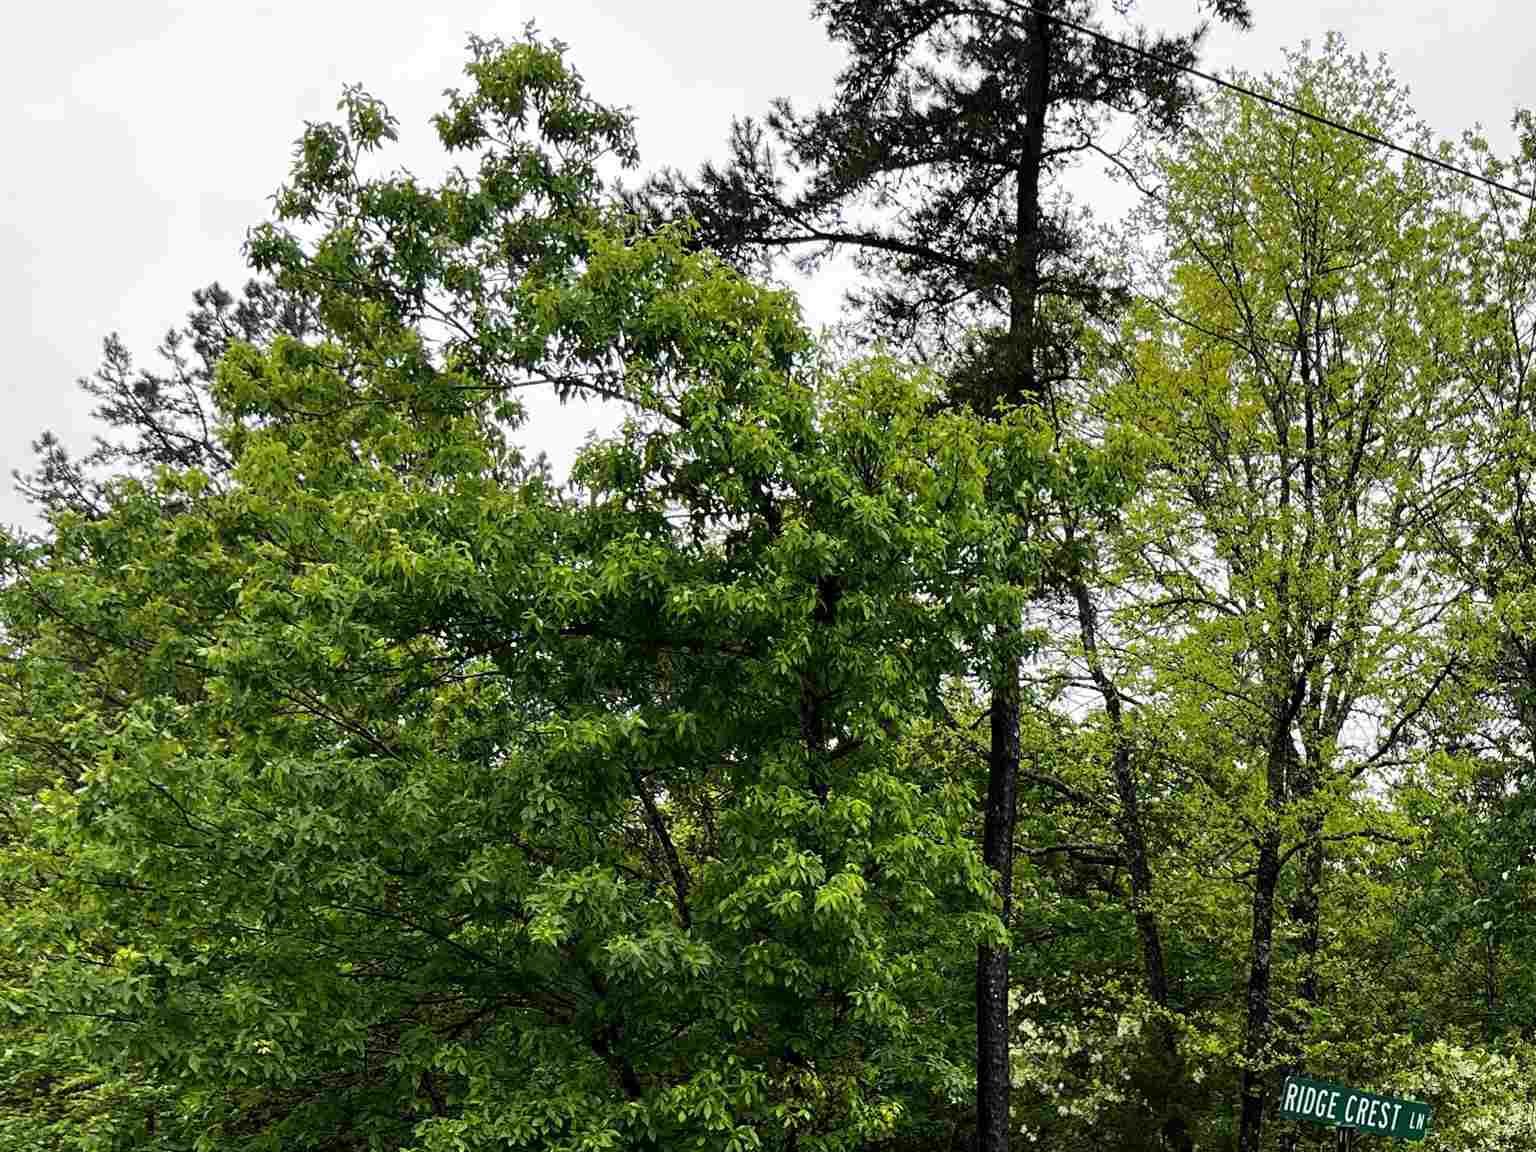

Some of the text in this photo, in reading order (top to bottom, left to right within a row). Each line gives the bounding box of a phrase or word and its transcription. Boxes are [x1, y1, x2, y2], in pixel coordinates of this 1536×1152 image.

[1284, 1083, 1425, 1131] RIDGE CREST LN
